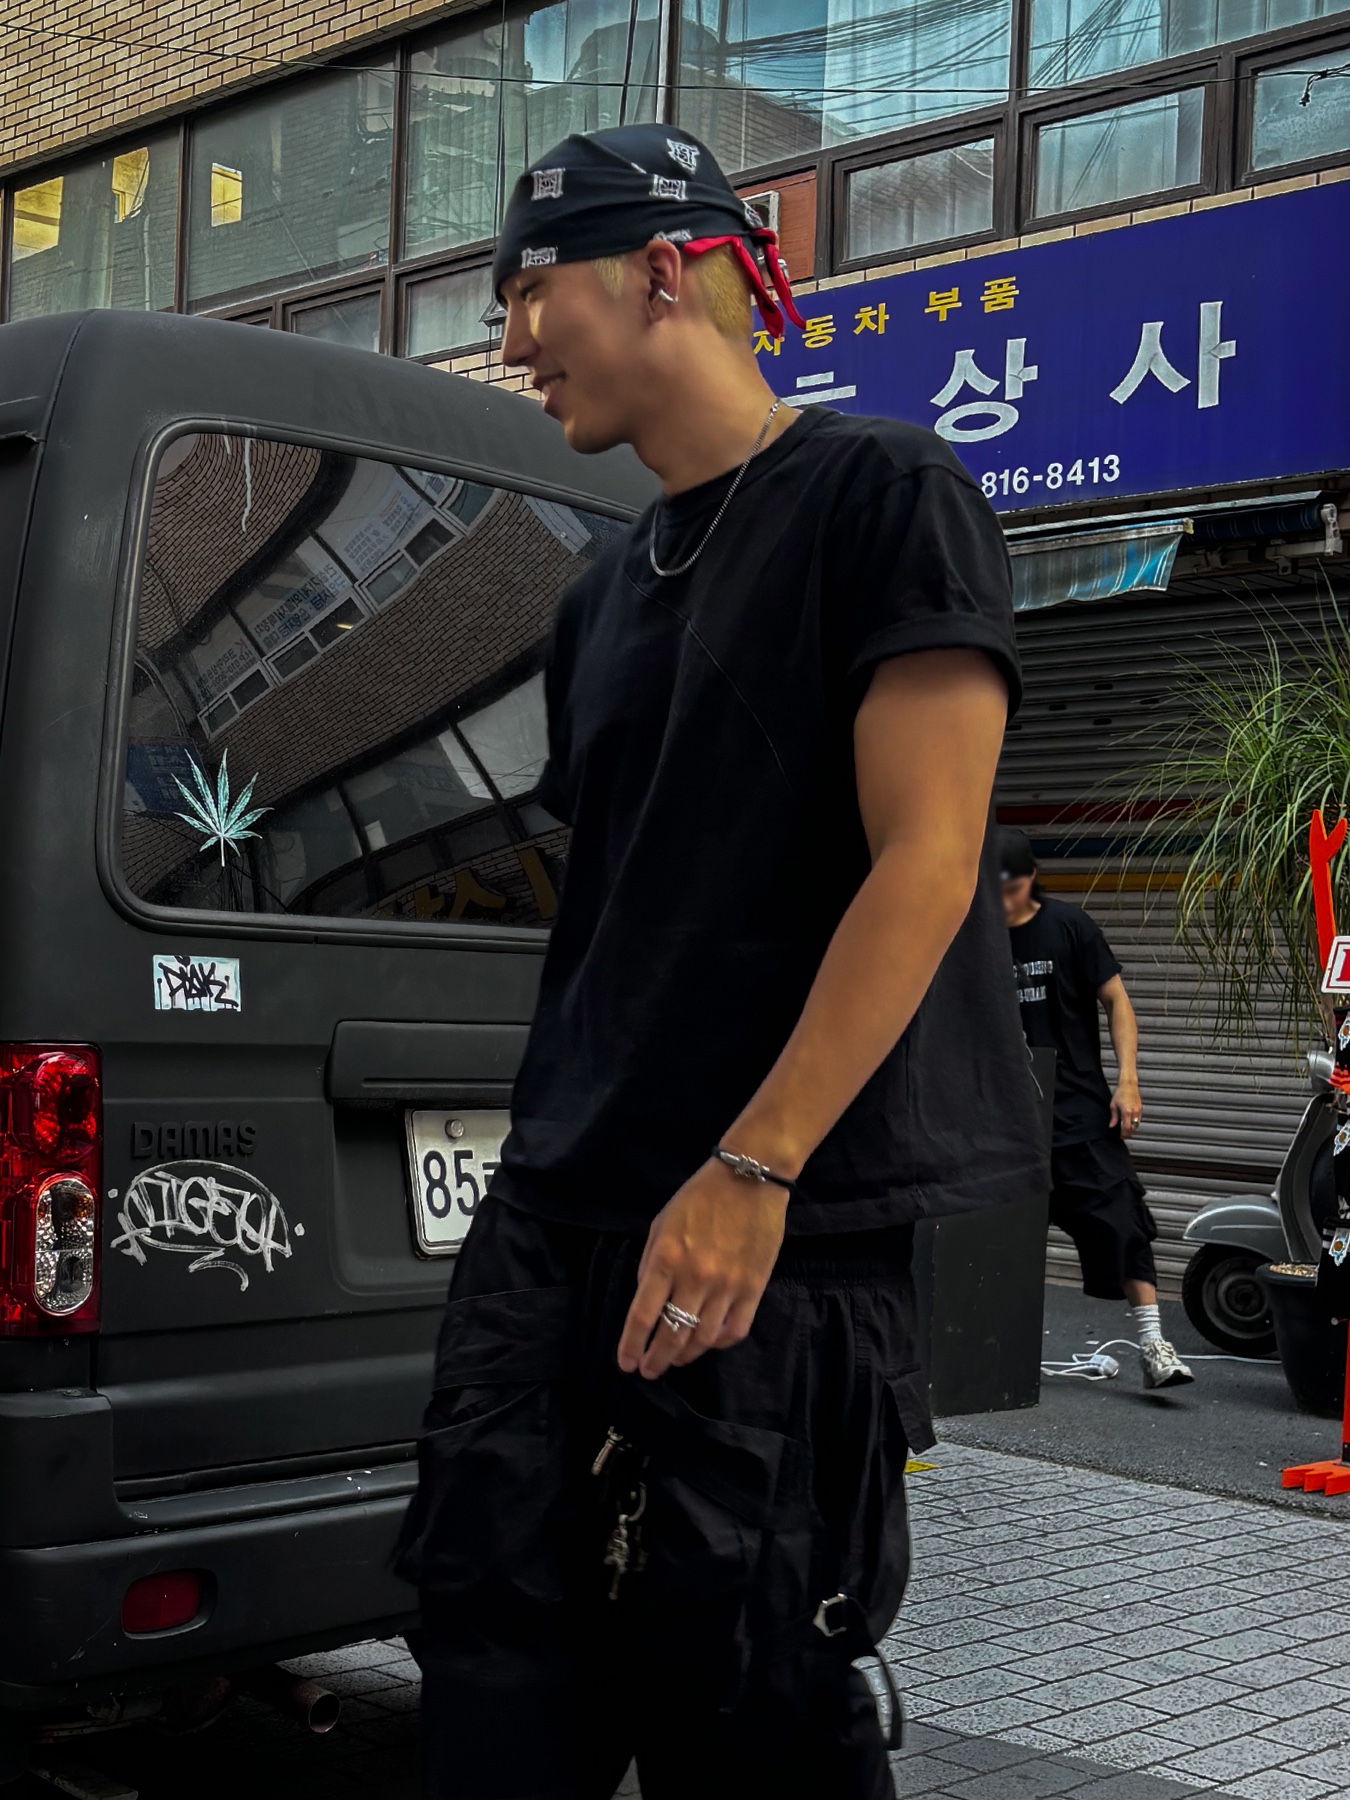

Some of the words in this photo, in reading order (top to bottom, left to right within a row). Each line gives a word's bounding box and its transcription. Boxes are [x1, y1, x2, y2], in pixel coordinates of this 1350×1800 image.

[753, 302, 889, 356] 자동차
[924, 276, 1019, 322] 부품
[981, 454, 1120, 499] 816-8413
[131, 1119, 258, 1159] DAMAS
